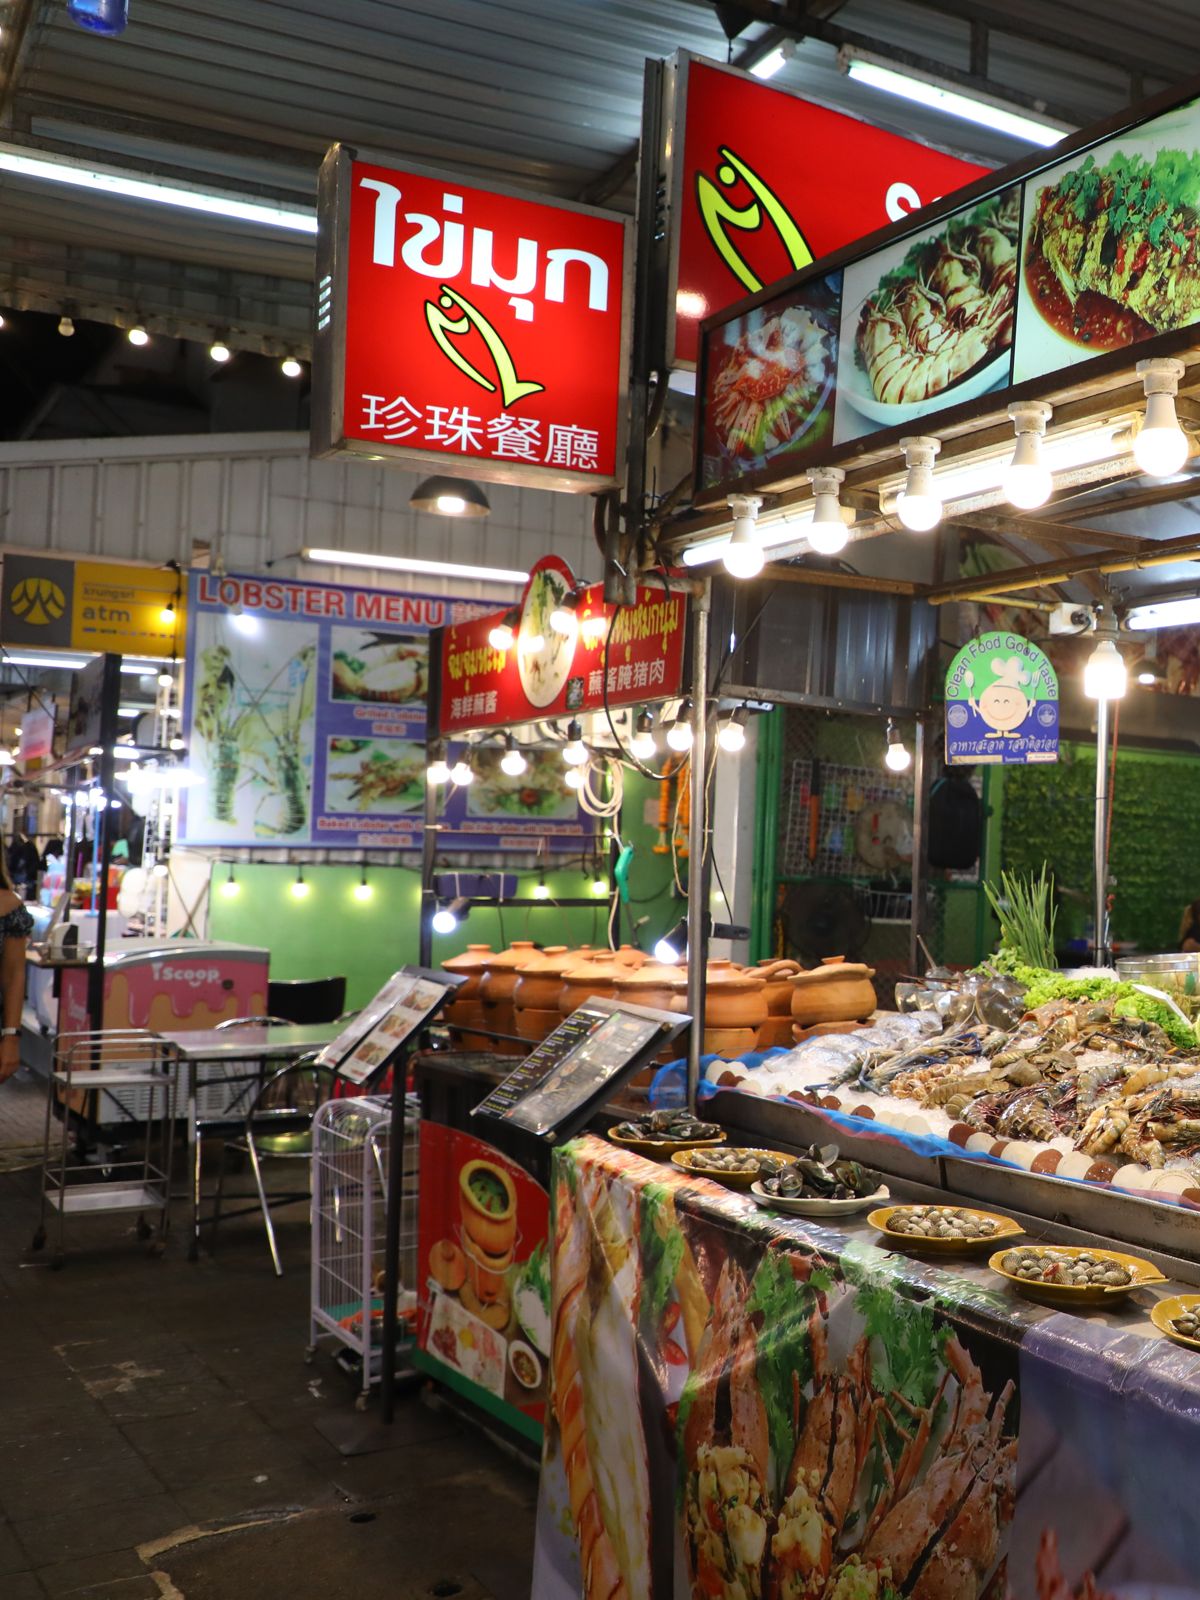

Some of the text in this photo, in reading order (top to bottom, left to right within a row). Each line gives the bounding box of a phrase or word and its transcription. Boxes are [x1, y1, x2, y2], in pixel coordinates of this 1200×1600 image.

[359, 177, 609, 322] ไข่มุก
[359, 394, 600, 470] 珍珠餐廳
[82, 604, 131, 623] atm
[83, 586, 135, 600] krungsri
[199, 576, 345, 617] LOBSTER
[354, 591, 445, 626] MENU
[946, 634, 1058, 699] Clean Food Good Taste
[949, 738, 1006, 755] อาหารสะอาด
